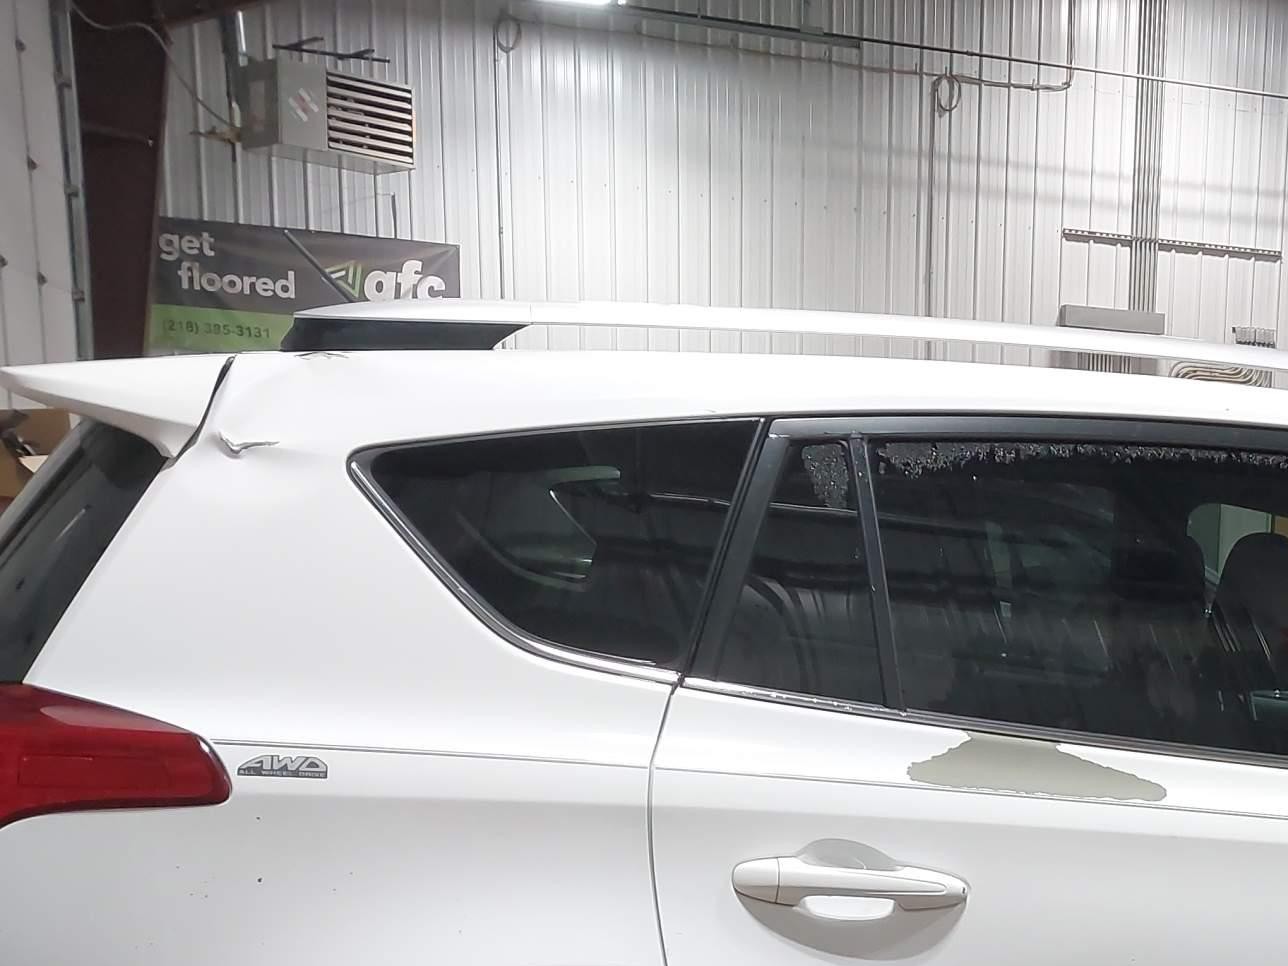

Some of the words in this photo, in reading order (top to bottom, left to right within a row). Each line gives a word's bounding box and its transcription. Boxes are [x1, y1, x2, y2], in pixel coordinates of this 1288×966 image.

[159, 231, 215, 261] get
[177, 260, 296, 300] floored
[364, 259, 446, 300] afc
[162, 319, 199, 336] (218)
[238, 754, 328, 772] AWD
